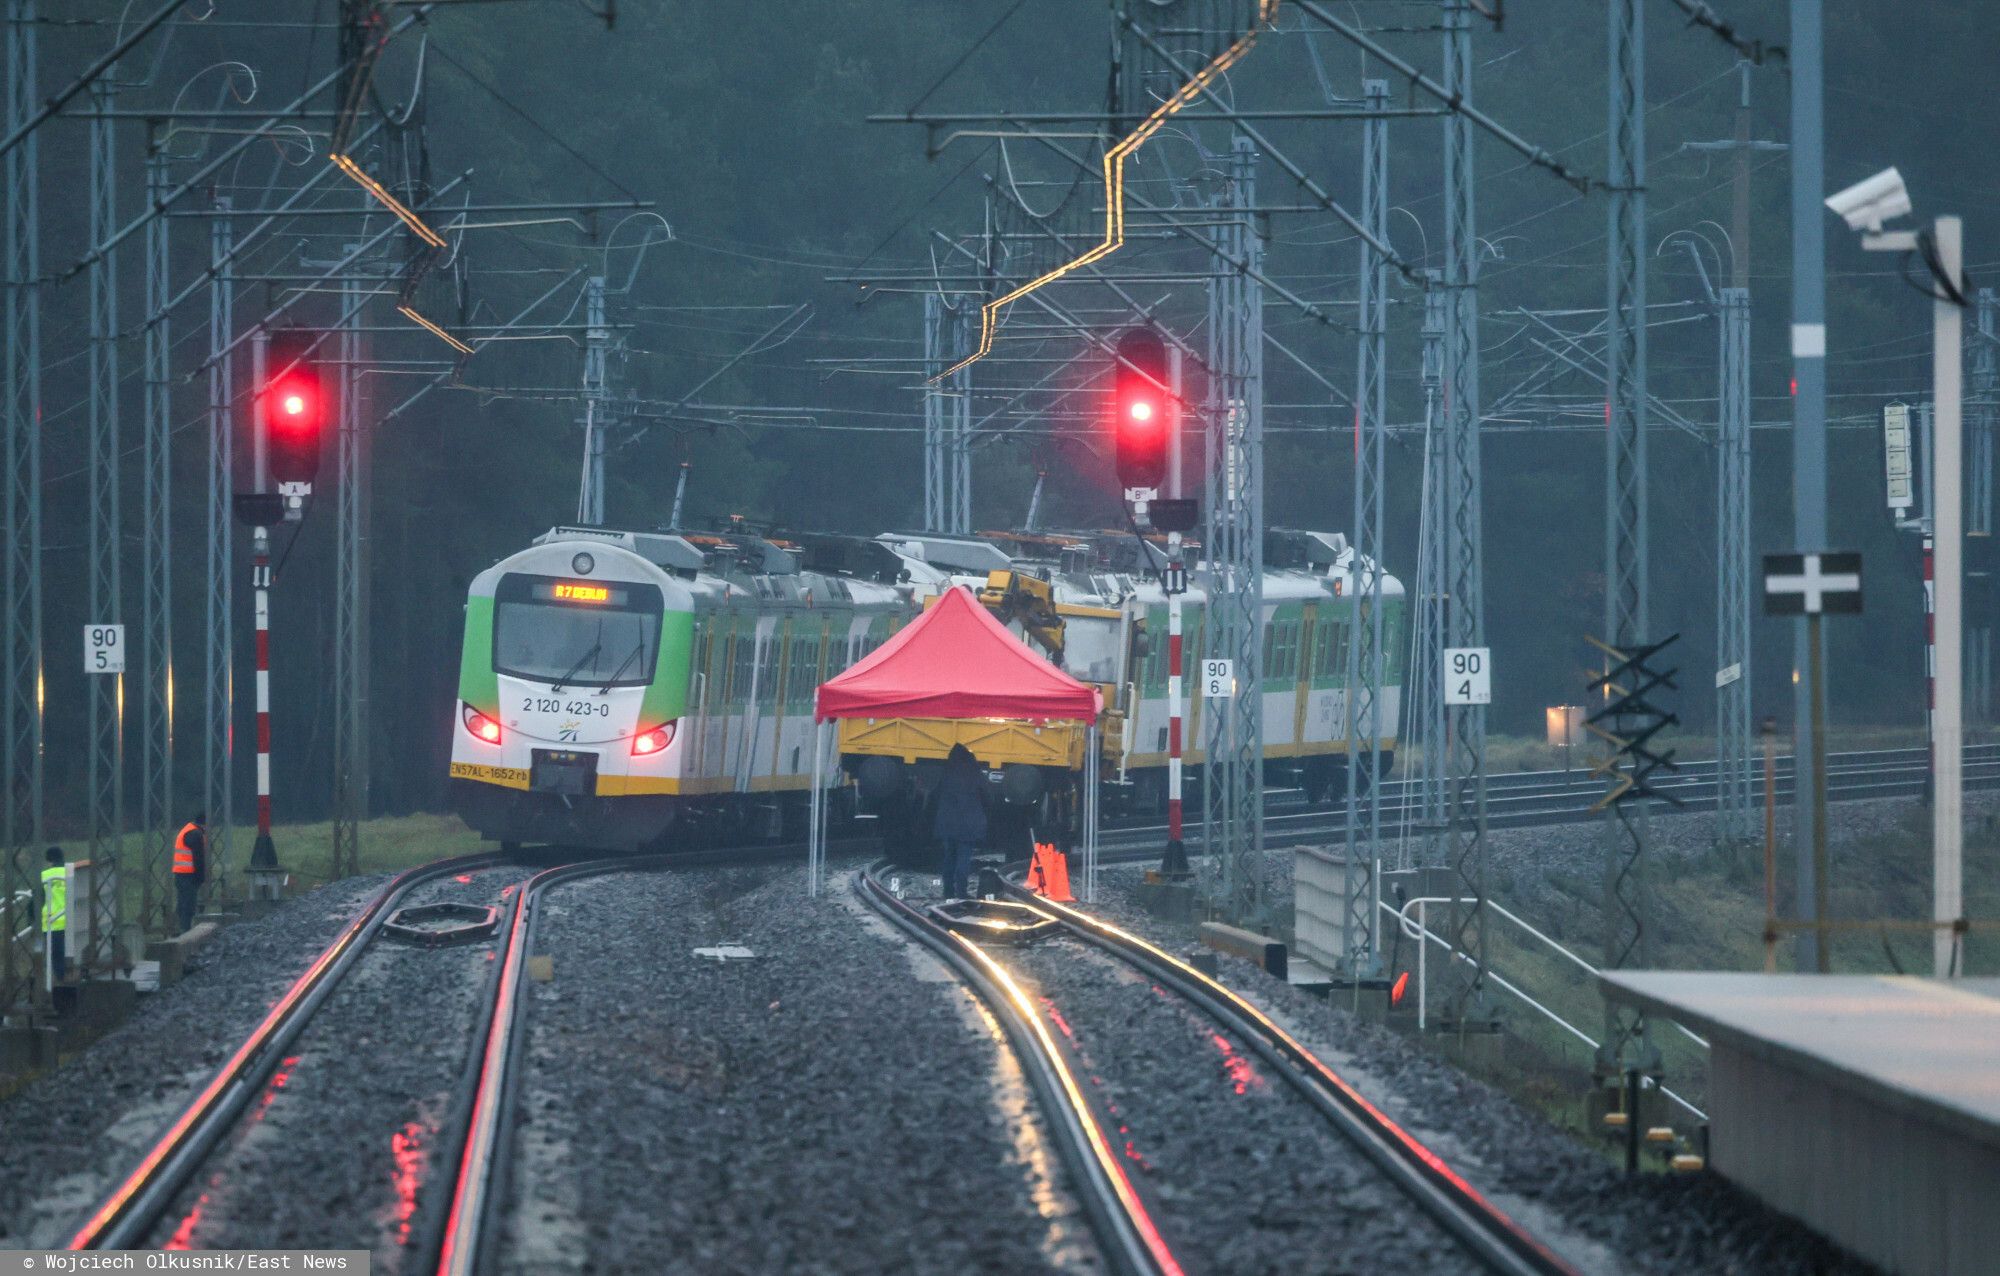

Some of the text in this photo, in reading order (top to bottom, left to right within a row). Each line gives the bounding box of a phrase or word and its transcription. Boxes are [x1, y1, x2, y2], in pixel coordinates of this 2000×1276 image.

[291, 484, 298, 494] A
[92, 628, 116, 647] 90
[96, 650, 107, 669] 5
[1453, 653, 1480, 674] 90
[1208, 662, 1227, 677] 90
[1210, 680, 1220, 694] 6
[1458, 679, 1470, 700] 4
[523, 698, 609, 717] 2 120 423-0
